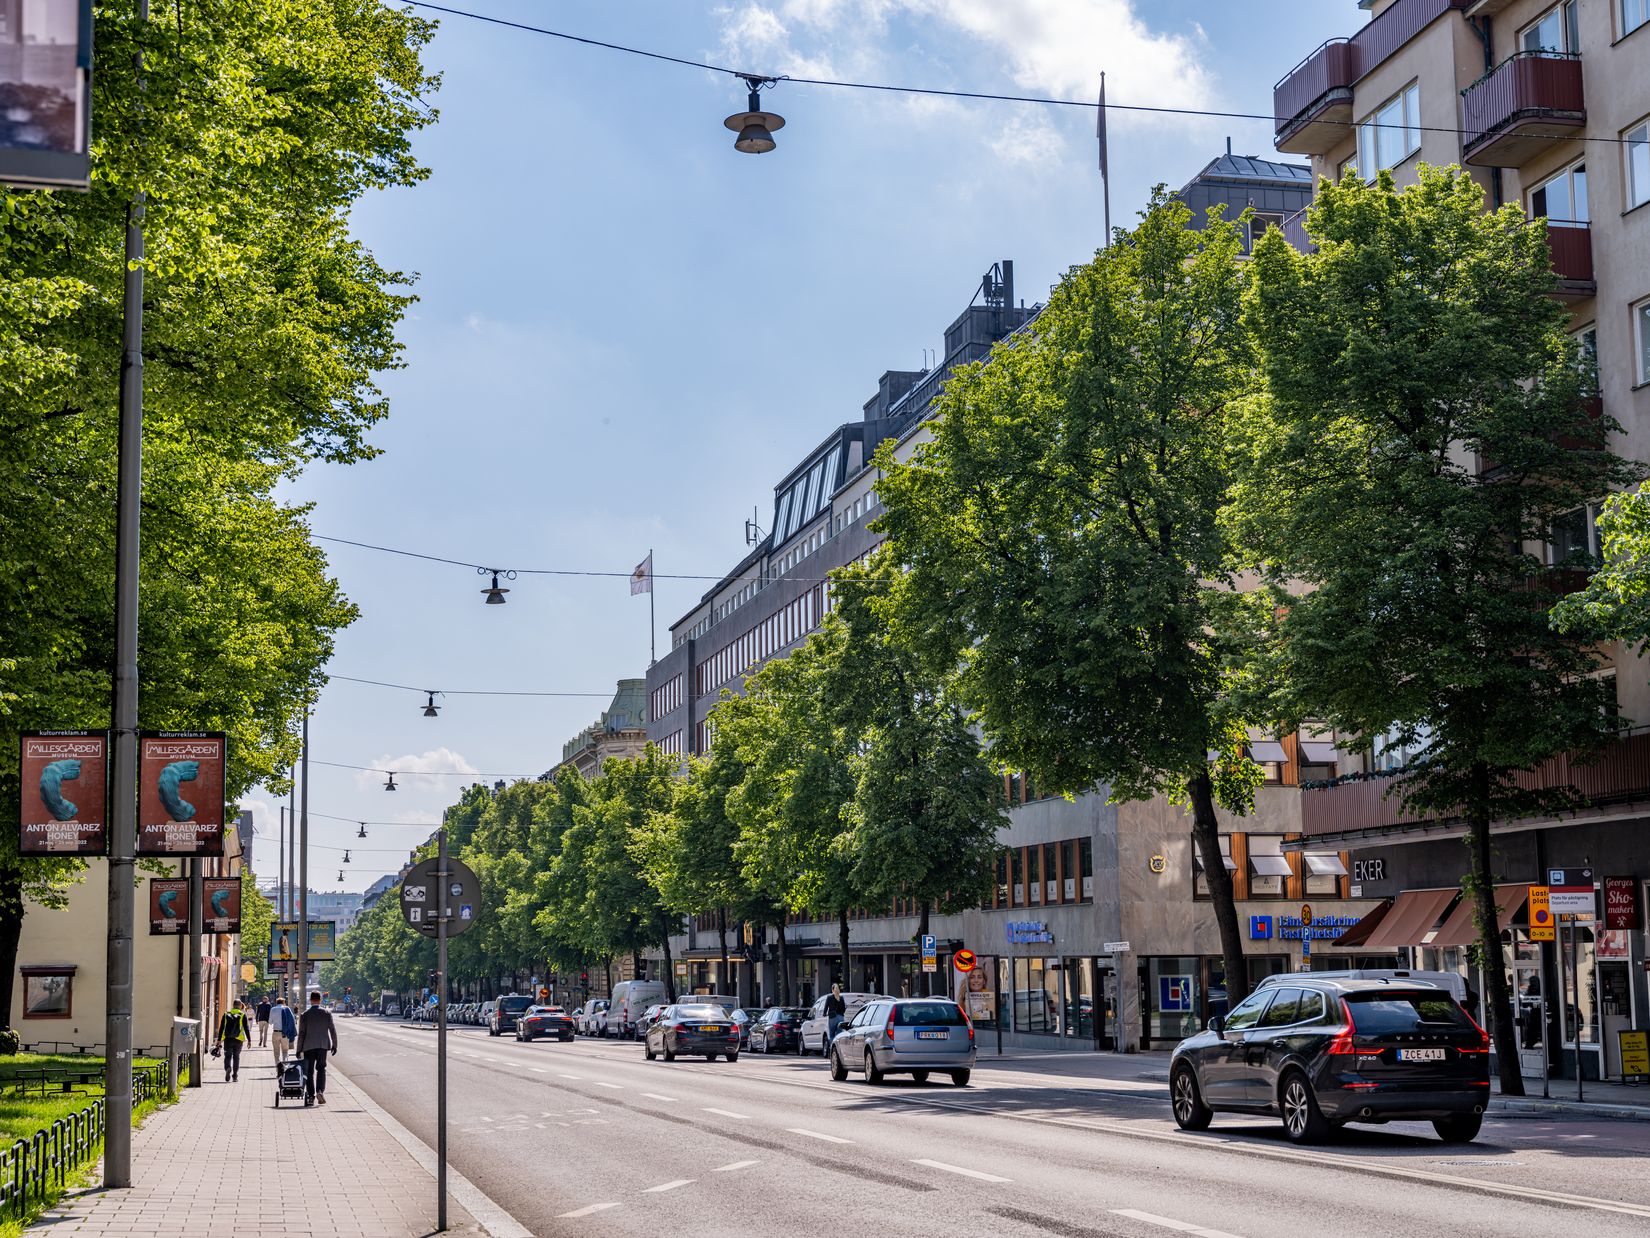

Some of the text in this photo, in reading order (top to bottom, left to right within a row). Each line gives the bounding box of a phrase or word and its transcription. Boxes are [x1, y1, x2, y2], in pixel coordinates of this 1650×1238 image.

[29, 743, 101, 753] MILLESGÅRDEN
[148, 744, 218, 754] MILLESGÅRDEN
[26, 823, 100, 832] ANTON ALVAREZ
[145, 824, 218, 833] ANTON ALVAREZ
[47, 832, 79, 840] HONEY
[165, 832, 197, 841] HONEY
[1354, 859, 1384, 881] EKER
[1605, 877, 1634, 889] Georges
[1608, 890, 1633, 904] Sko-
[1607, 905, 1634, 914] makeri
[925, 936, 934, 948] P
[1404, 1049, 1422, 1059] ZCE
